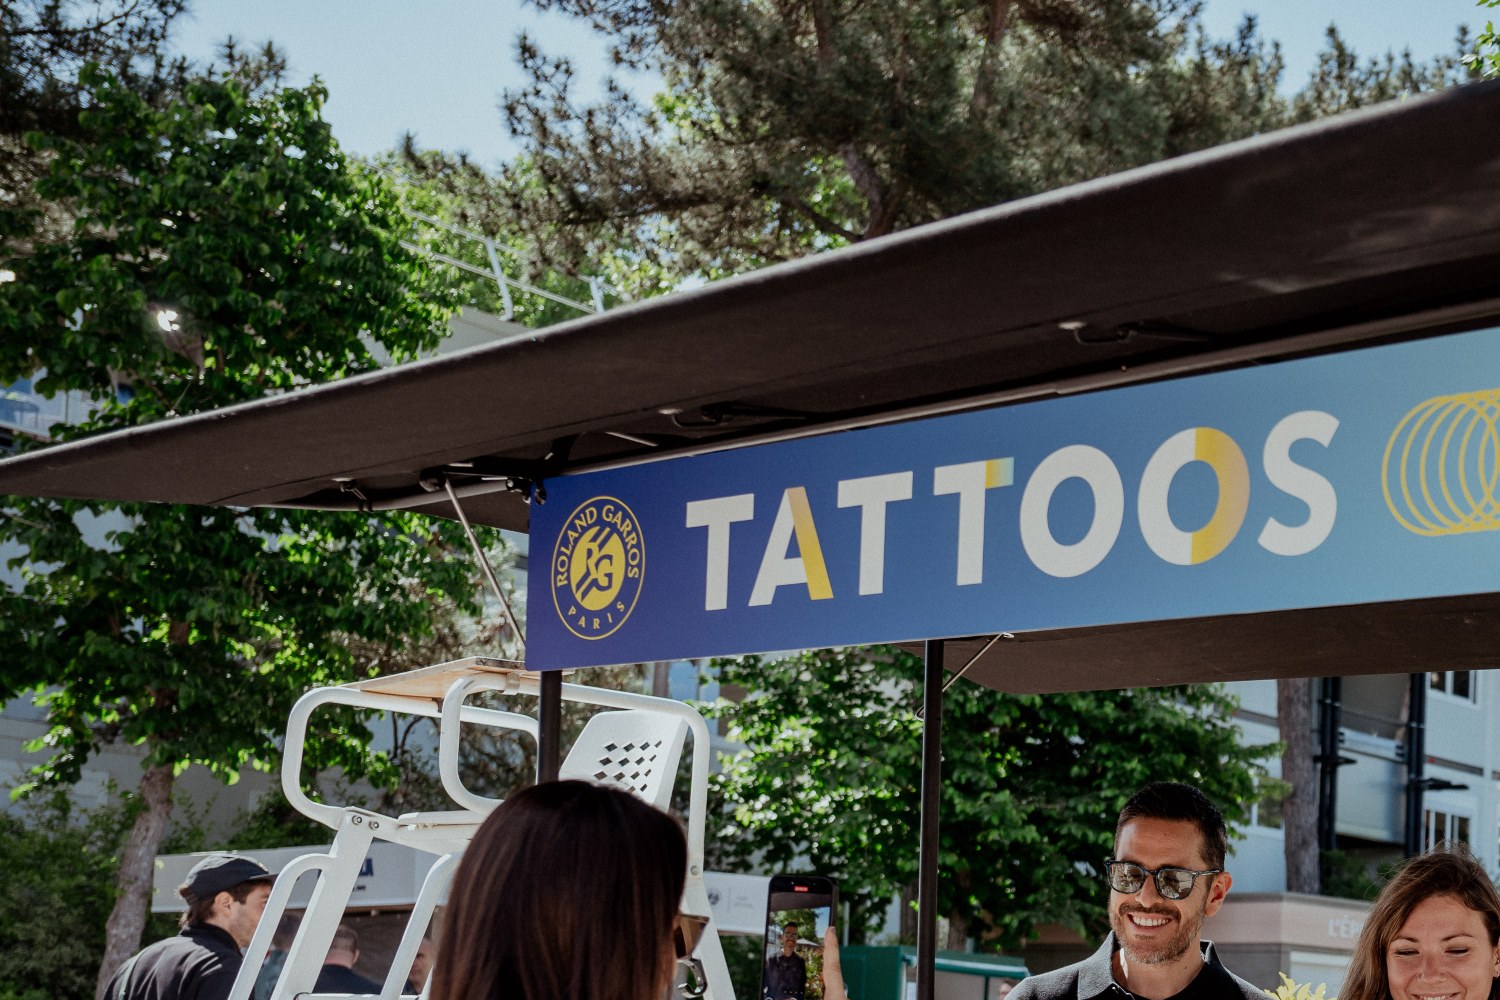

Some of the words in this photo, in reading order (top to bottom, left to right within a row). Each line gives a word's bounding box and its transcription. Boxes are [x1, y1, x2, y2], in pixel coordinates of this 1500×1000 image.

[556, 506, 598, 588] ROLAND
[602, 504, 640, 579] GARROS
[686, 410, 1340, 612] TATTOOS
[567, 601, 625, 630] PARIS
